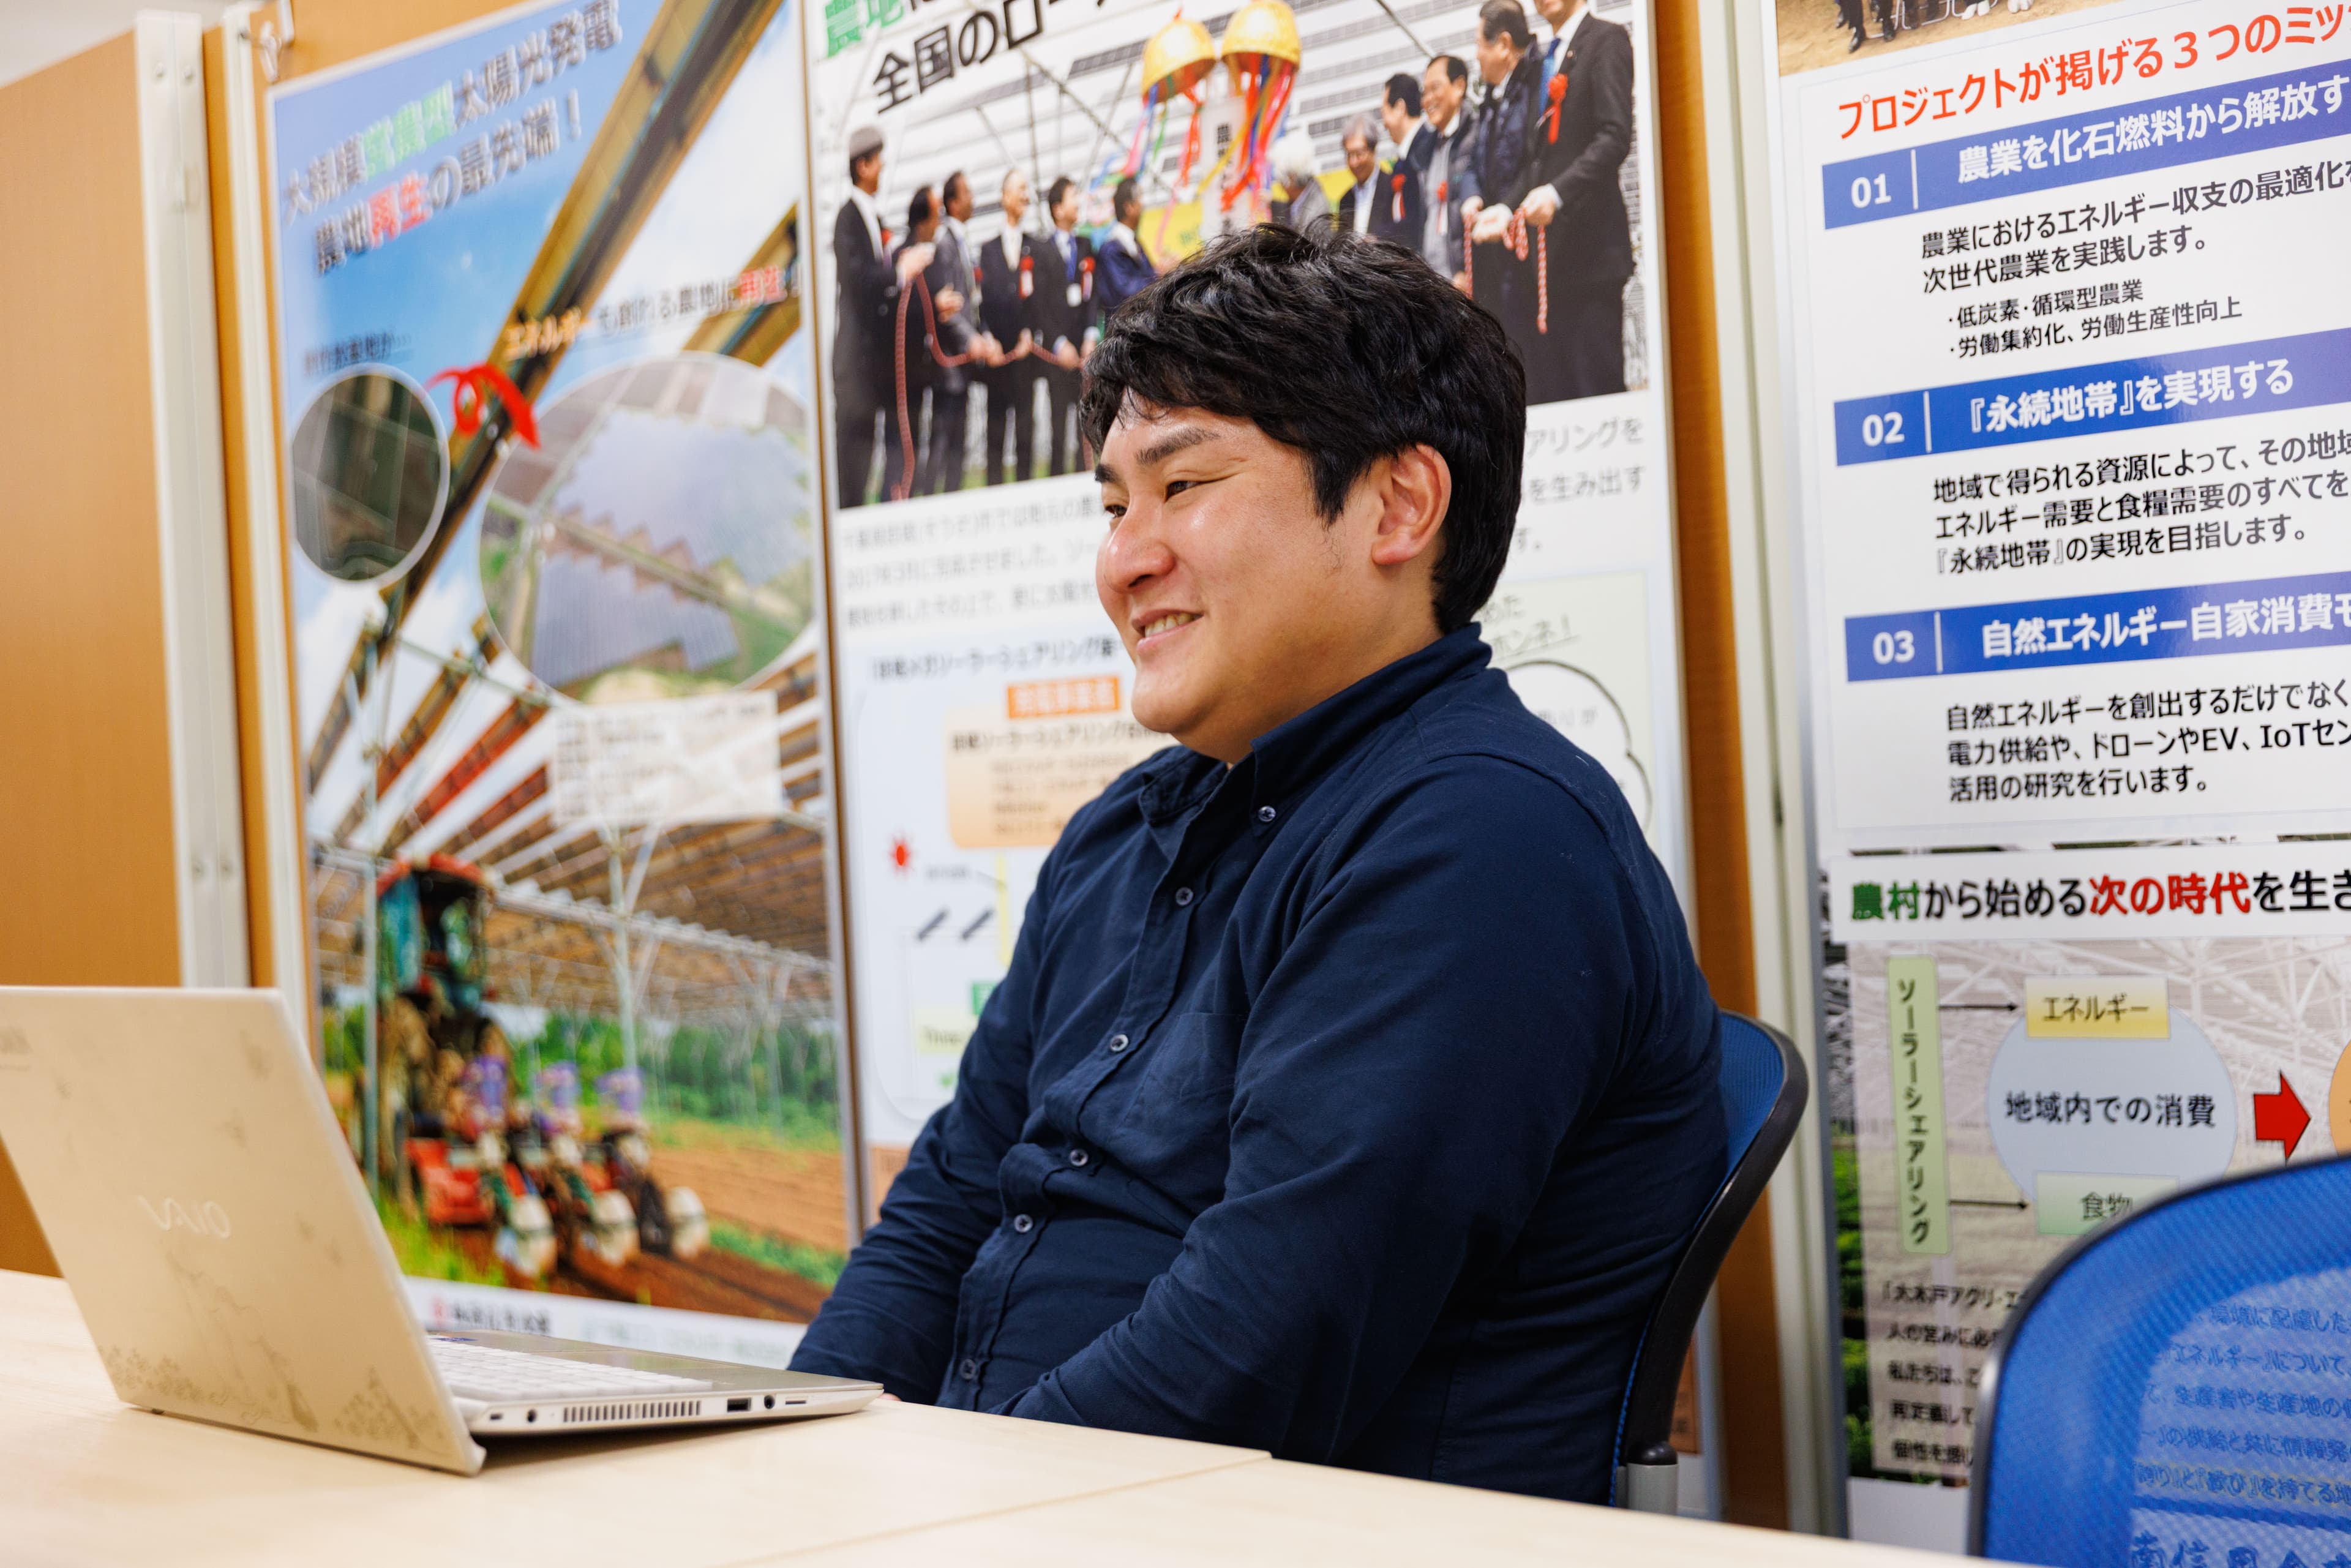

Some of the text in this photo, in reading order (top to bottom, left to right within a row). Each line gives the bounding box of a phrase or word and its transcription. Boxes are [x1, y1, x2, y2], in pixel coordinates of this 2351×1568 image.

[1839, 2, 2351, 139] プロジェクトが掲げる3つのミッ
[1957, 74, 2350, 185] 農業を化石燃料から解放す
[1850, 176, 1892, 209] 01
[1921, 159, 2351, 260] 農業におけるエネルギー収支の最適化
[1921, 224, 2207, 294] 次世代農業を実践します。
[1970, 358, 2295, 434] 『永続地帯』を実現する
[1861, 413, 1906, 447] 02
[1934, 469, 2349, 541] エネルギー需要と食糧需要のすべてを
[1935, 512, 2308, 576] 『永続地帯』の実現を目指します。
[1871, 630, 1916, 666] 03
[1947, 677, 2349, 732] 自然エネルギーを創出するだけでなく
[1949, 763, 2208, 803] 活用の研究を行います。
[2042, 992, 2151, 1025] エネルギー
[1897, 979, 1931, 1245] ソーラーシェアリング
[2005, 1089, 2217, 1128] 地域内での消費
